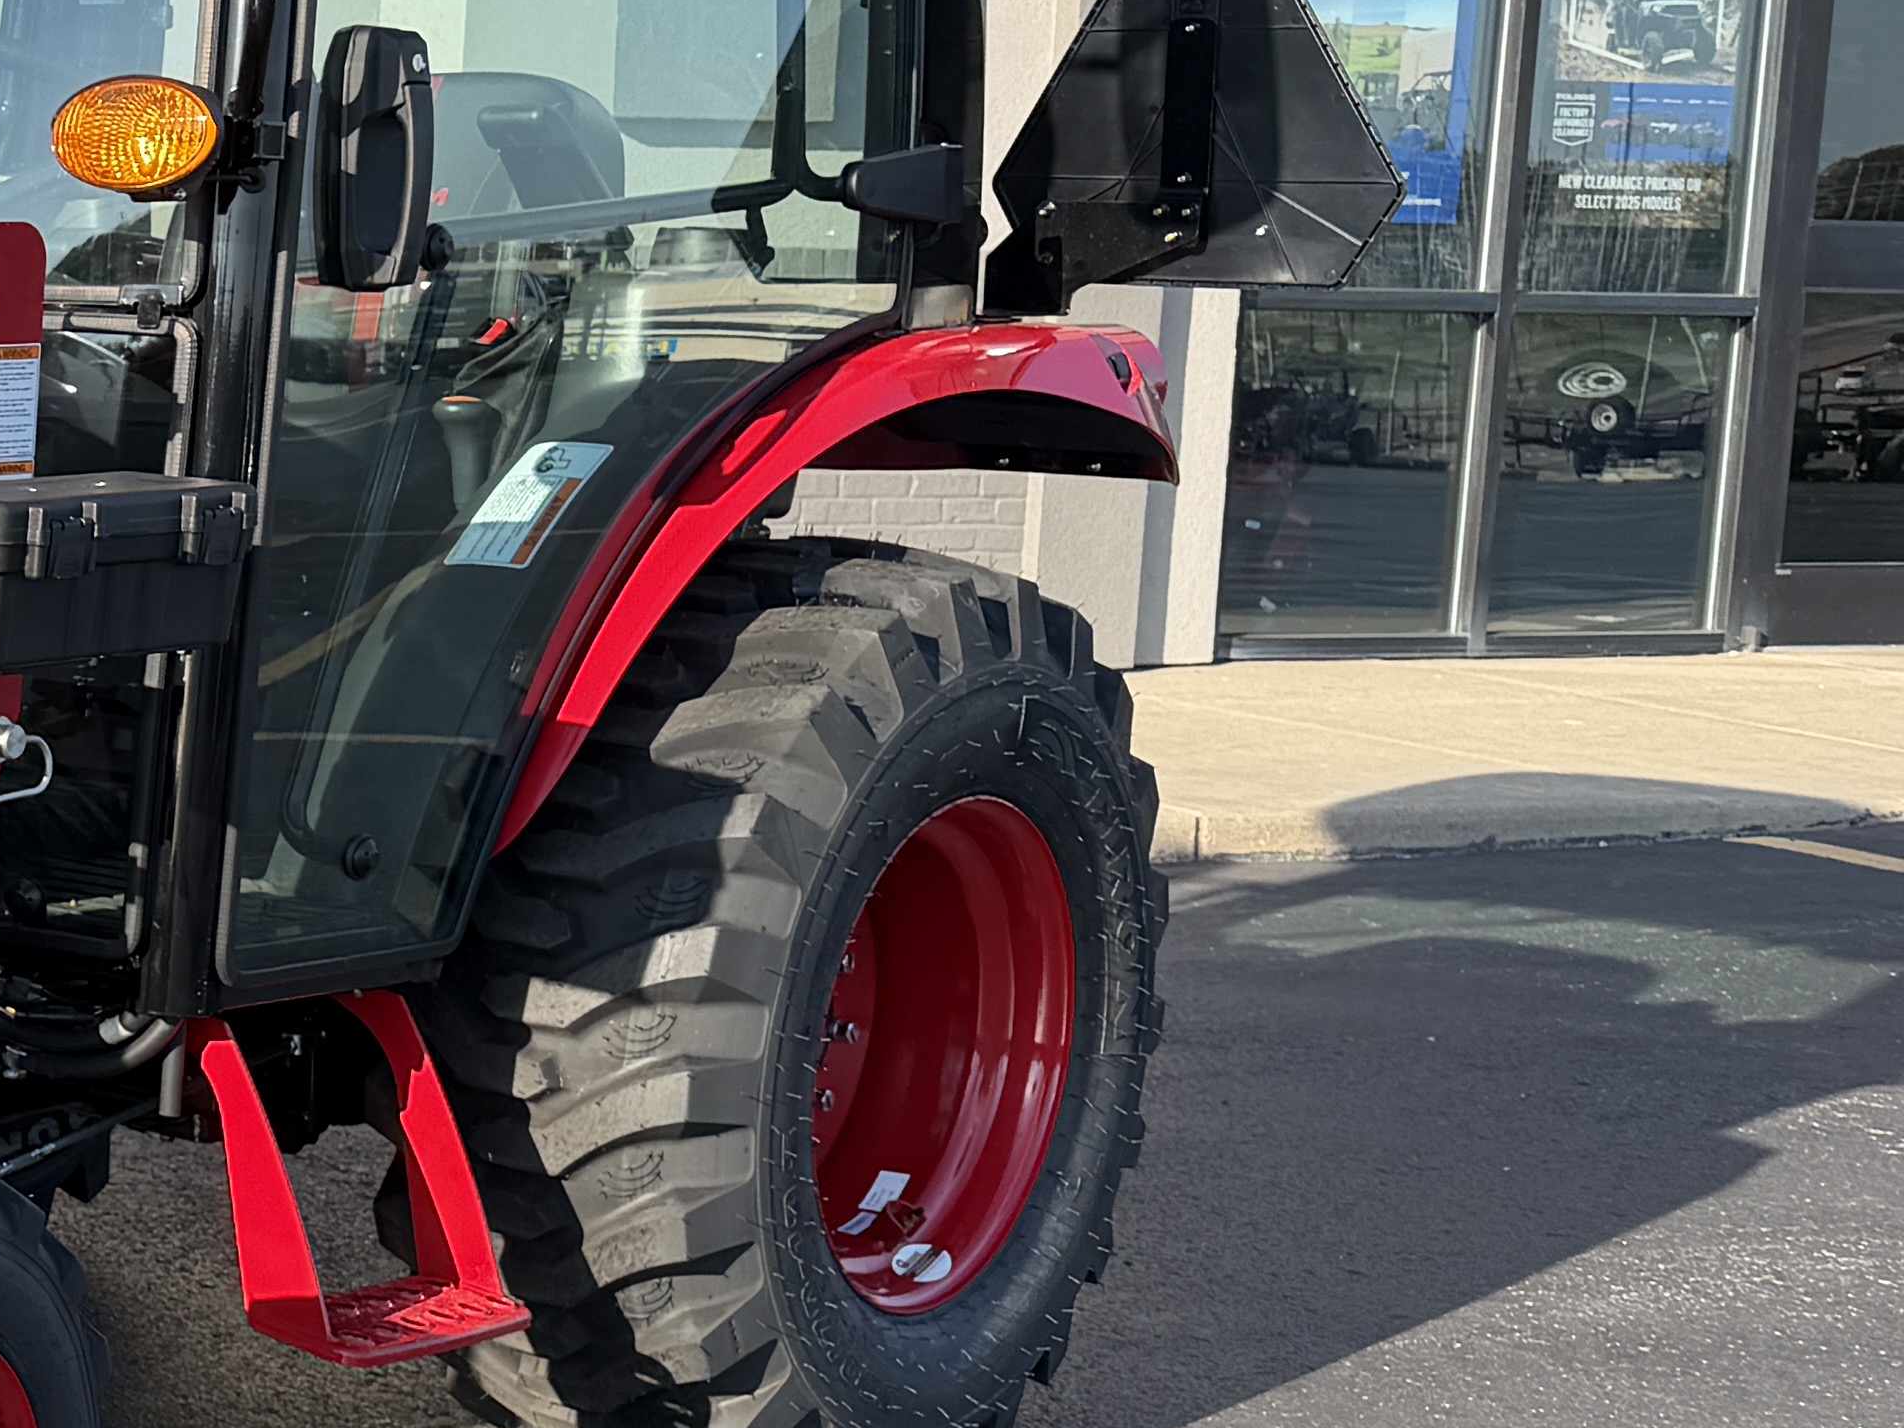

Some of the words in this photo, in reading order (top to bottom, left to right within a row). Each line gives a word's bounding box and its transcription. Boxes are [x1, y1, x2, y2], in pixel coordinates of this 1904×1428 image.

[1558, 174, 1583, 189] NEW
[1584, 175, 1644, 190] CLEARANCE
[1645, 176, 1685, 191] PRICING
[1687, 178, 1701, 192] ON
[1574, 194, 1613, 209] SELECT
[1614, 195, 1641, 210] 2025
[1642, 196, 1681, 211] MODELS
